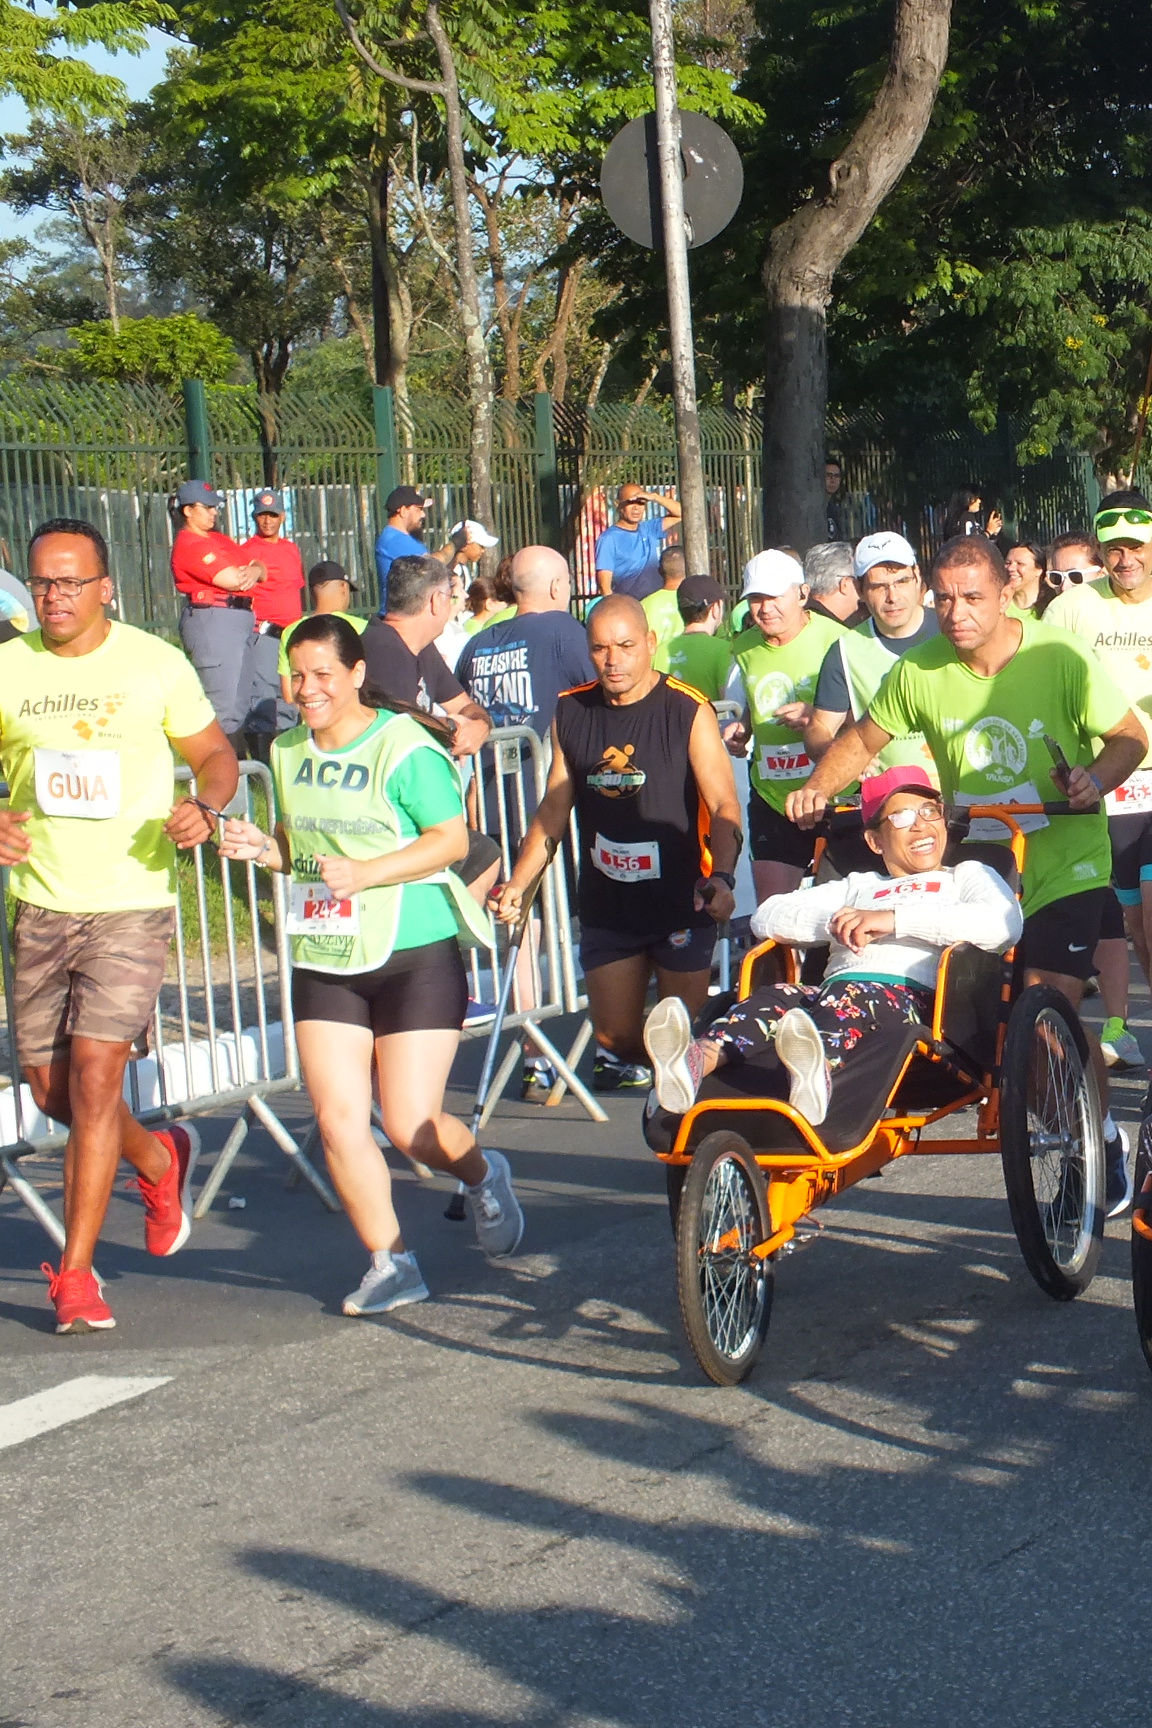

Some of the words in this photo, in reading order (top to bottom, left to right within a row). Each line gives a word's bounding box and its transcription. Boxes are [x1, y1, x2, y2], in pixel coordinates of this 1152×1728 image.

[18, 694, 99, 718] Achilles
[773, 755, 799, 770] 177
[293, 757, 370, 792] ACD
[47, 771, 109, 801] GUIA
[608, 853, 640, 870] 156
[890, 881, 927, 895] 163
[311, 900, 341, 918] 242
